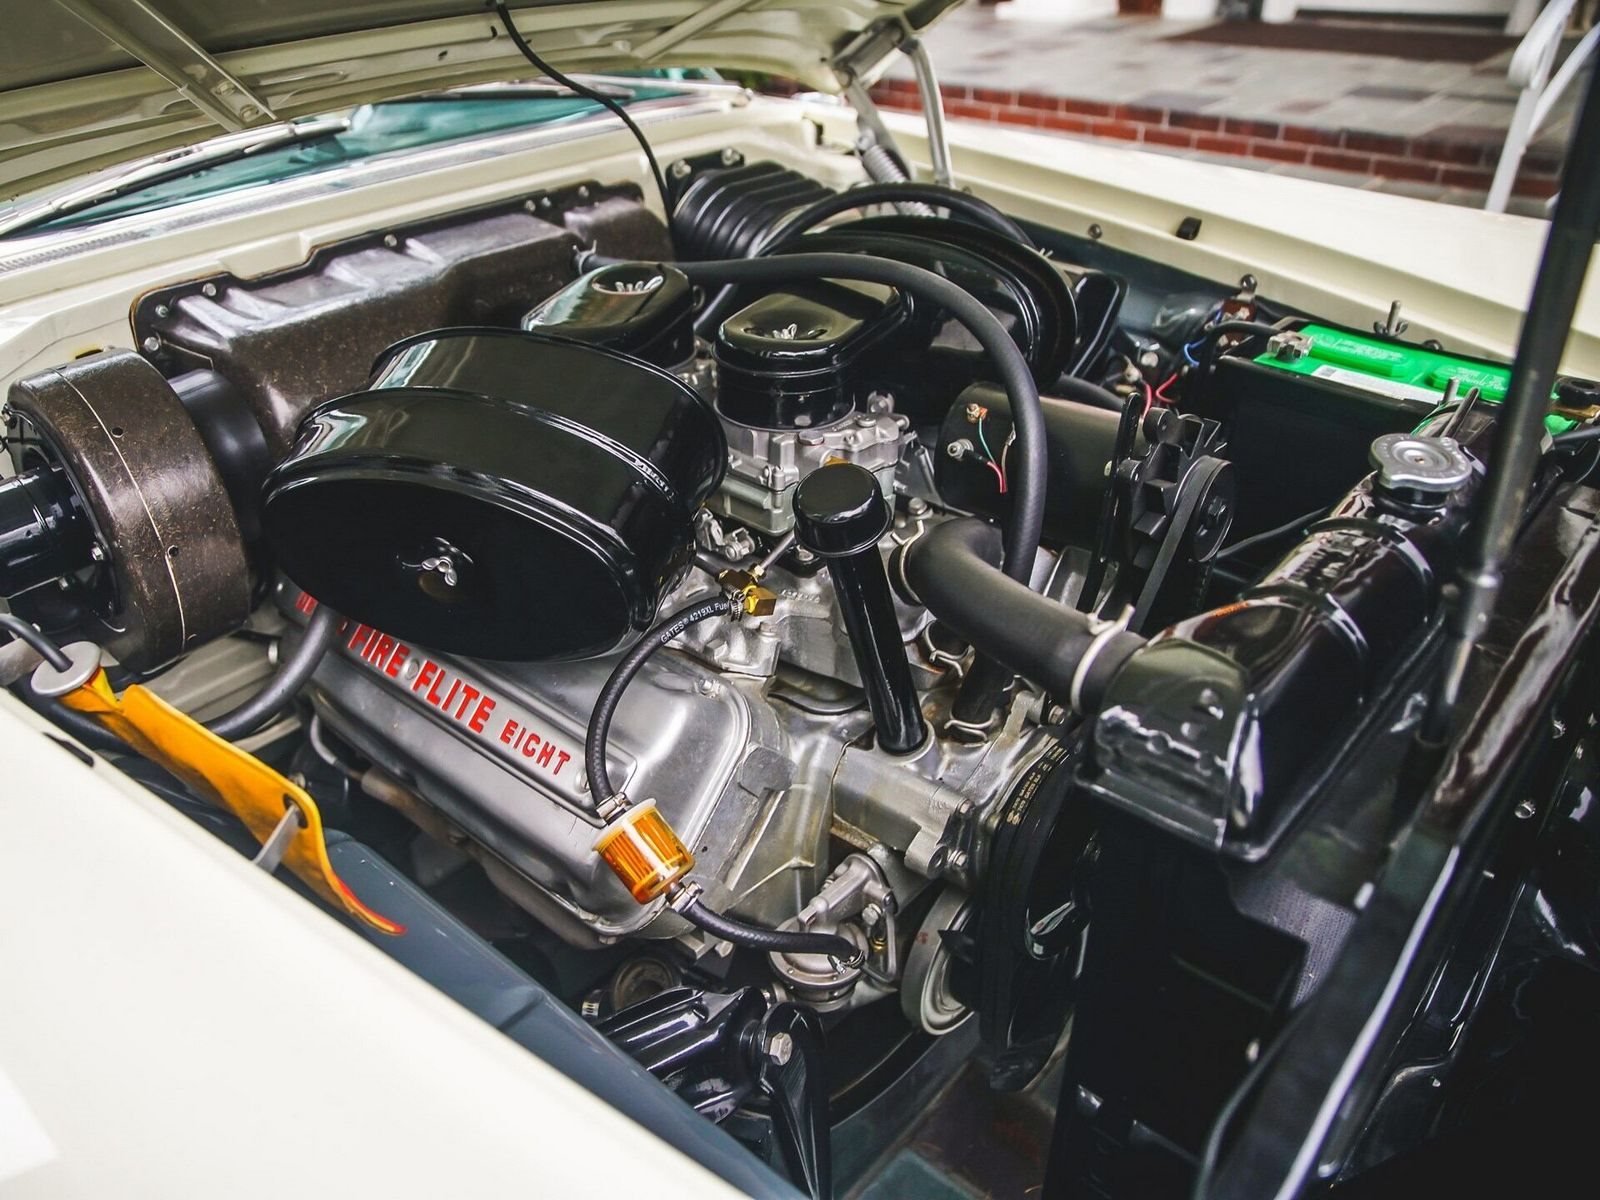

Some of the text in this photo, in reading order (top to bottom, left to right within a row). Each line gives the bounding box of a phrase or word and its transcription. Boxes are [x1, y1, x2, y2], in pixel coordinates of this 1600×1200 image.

[689, 605, 714, 622] 4219XL
[347, 623, 571, 775] FIRE FLITE EIGHT
